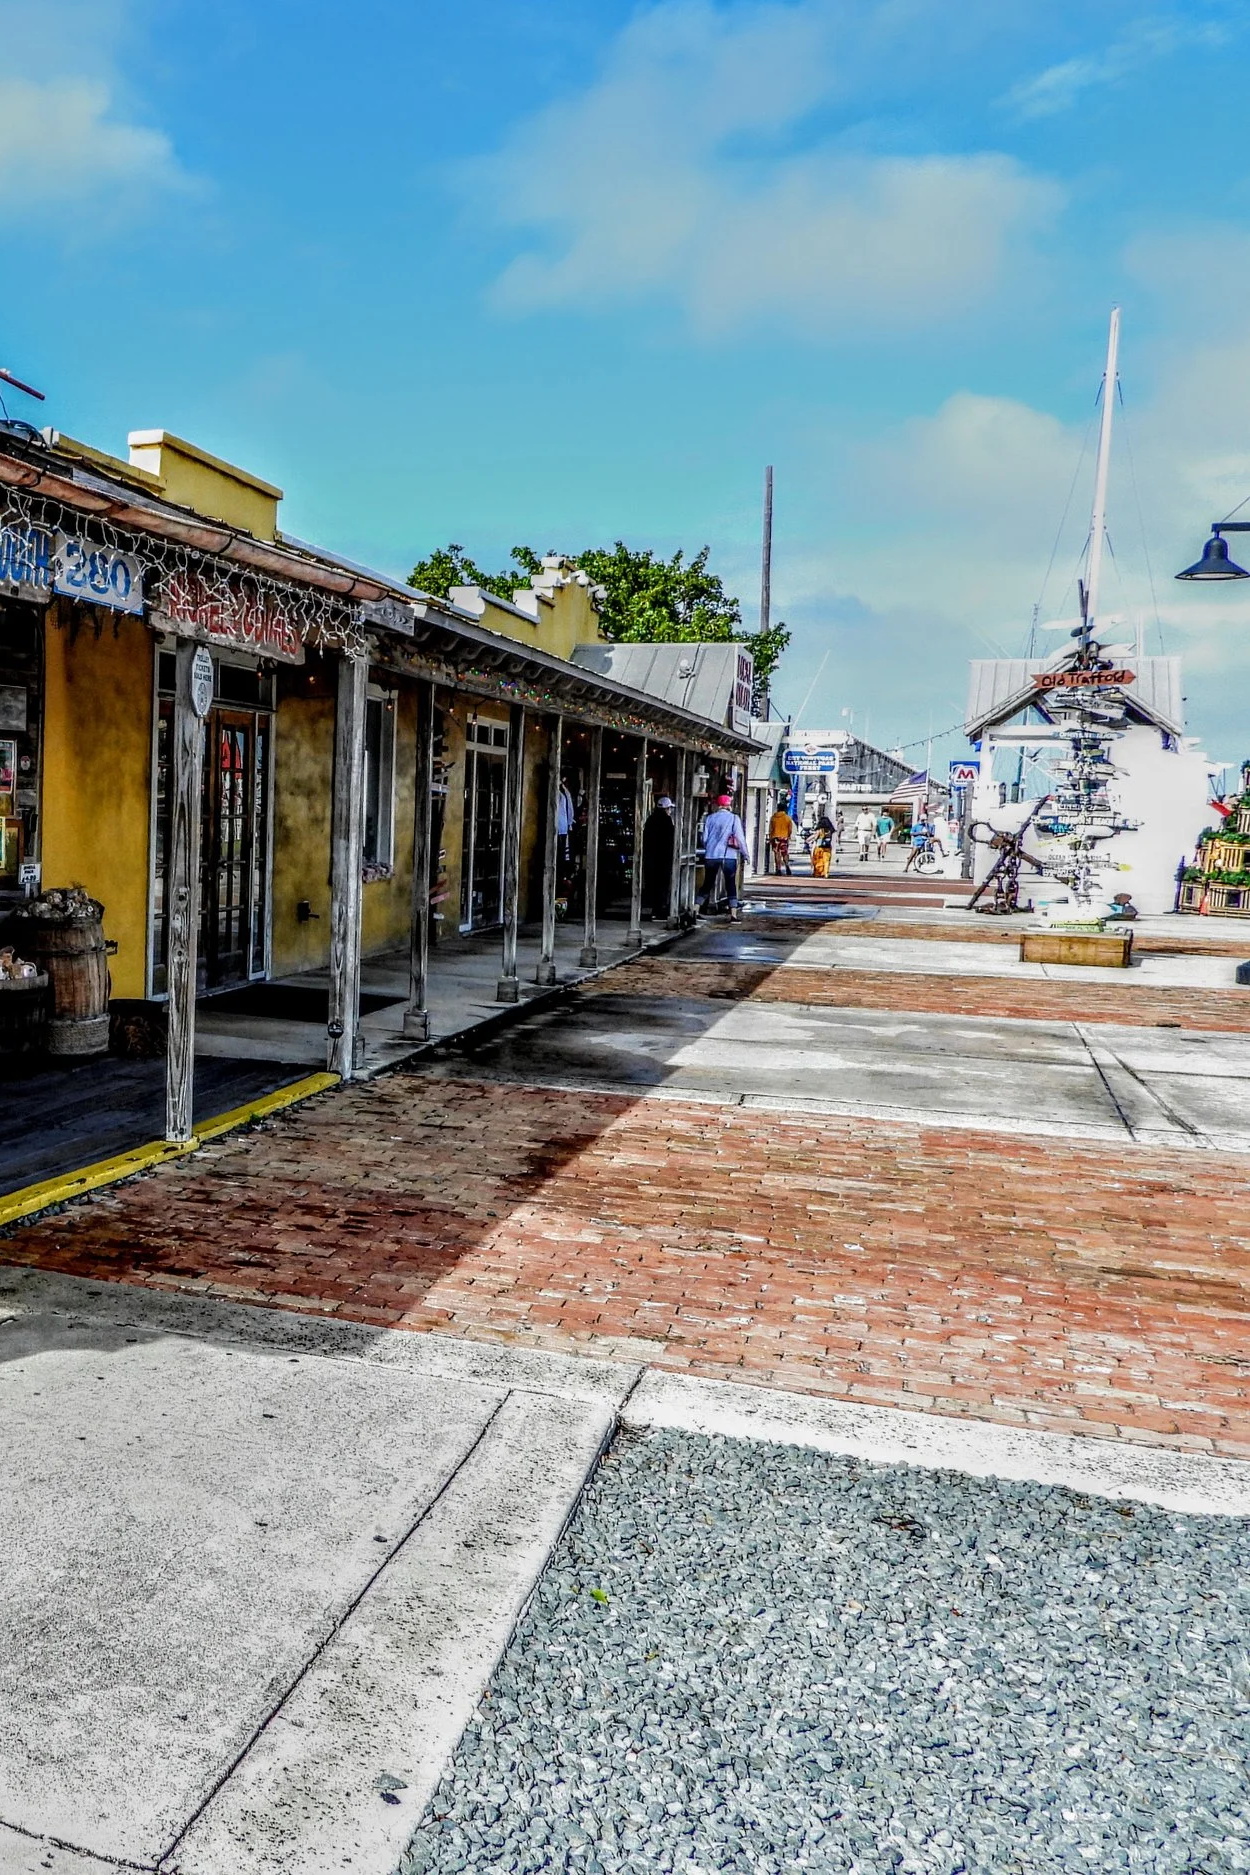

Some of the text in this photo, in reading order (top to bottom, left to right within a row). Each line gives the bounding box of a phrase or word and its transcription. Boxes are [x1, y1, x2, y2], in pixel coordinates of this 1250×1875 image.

[66, 542, 131, 599] 280
[1041, 670, 1125, 687] Old Trafford
